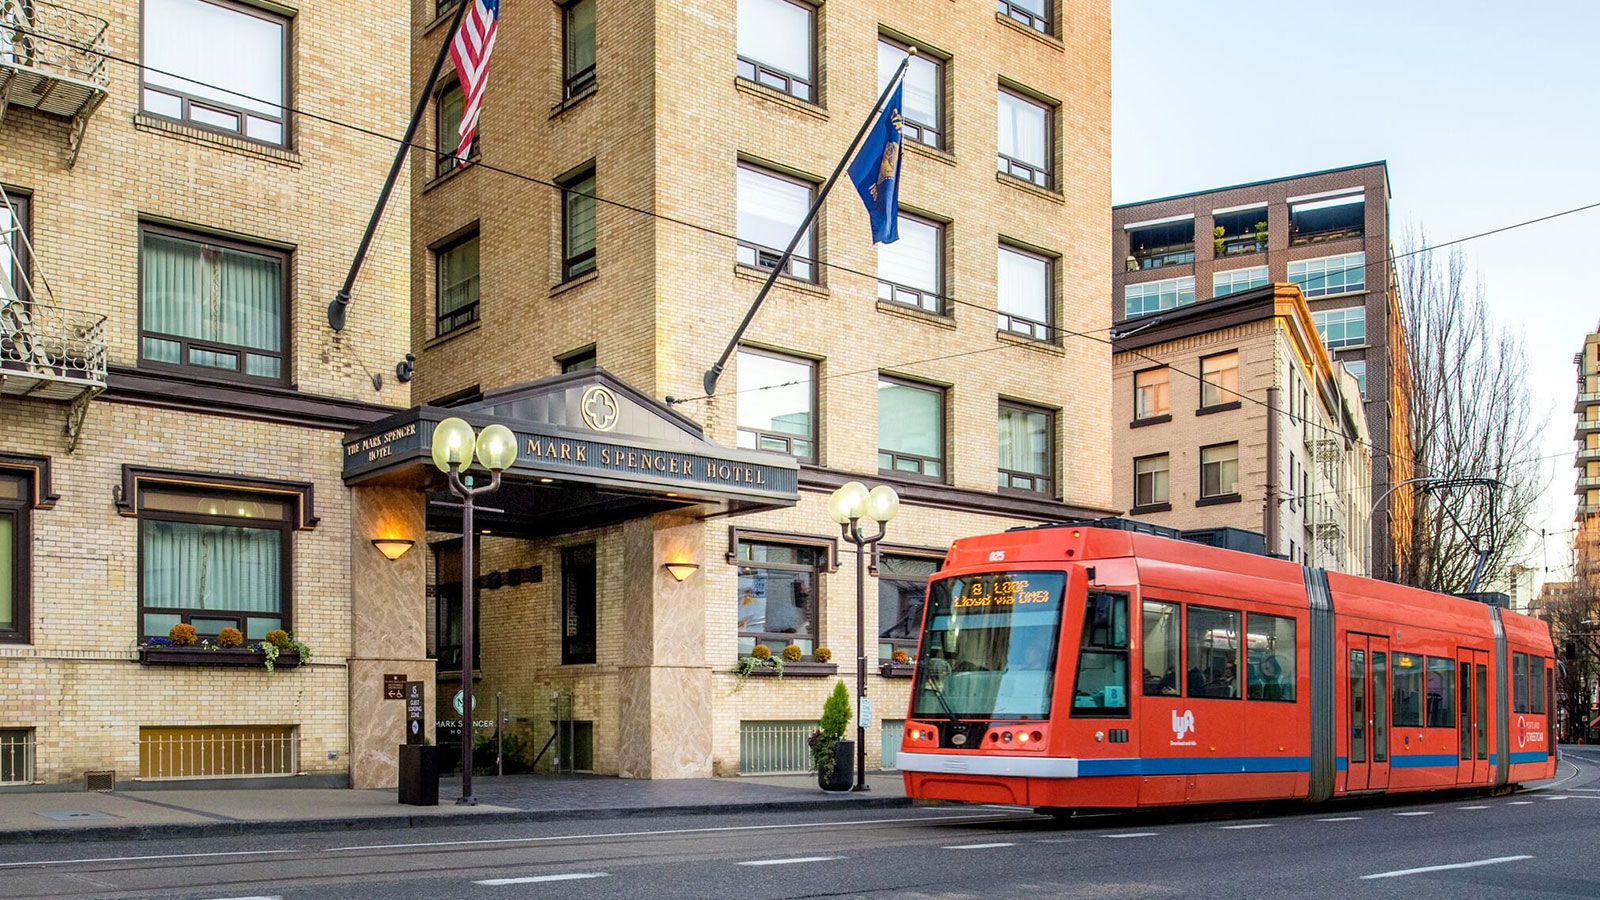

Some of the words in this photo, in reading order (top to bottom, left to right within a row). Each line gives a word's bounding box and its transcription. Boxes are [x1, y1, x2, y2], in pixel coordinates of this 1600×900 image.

[347, 442, 360, 456] THE
[362, 435, 382, 451] MARK
[383, 423, 416, 443] SPENCER
[368, 445, 393, 462] HOTEL
[526, 438, 588, 462] MARK
[601, 448, 694, 476] SPENCER
[706, 462, 766, 485] HOTEL
[435, 720, 456, 728] MARK
[457, 720, 494, 728] SNCER
